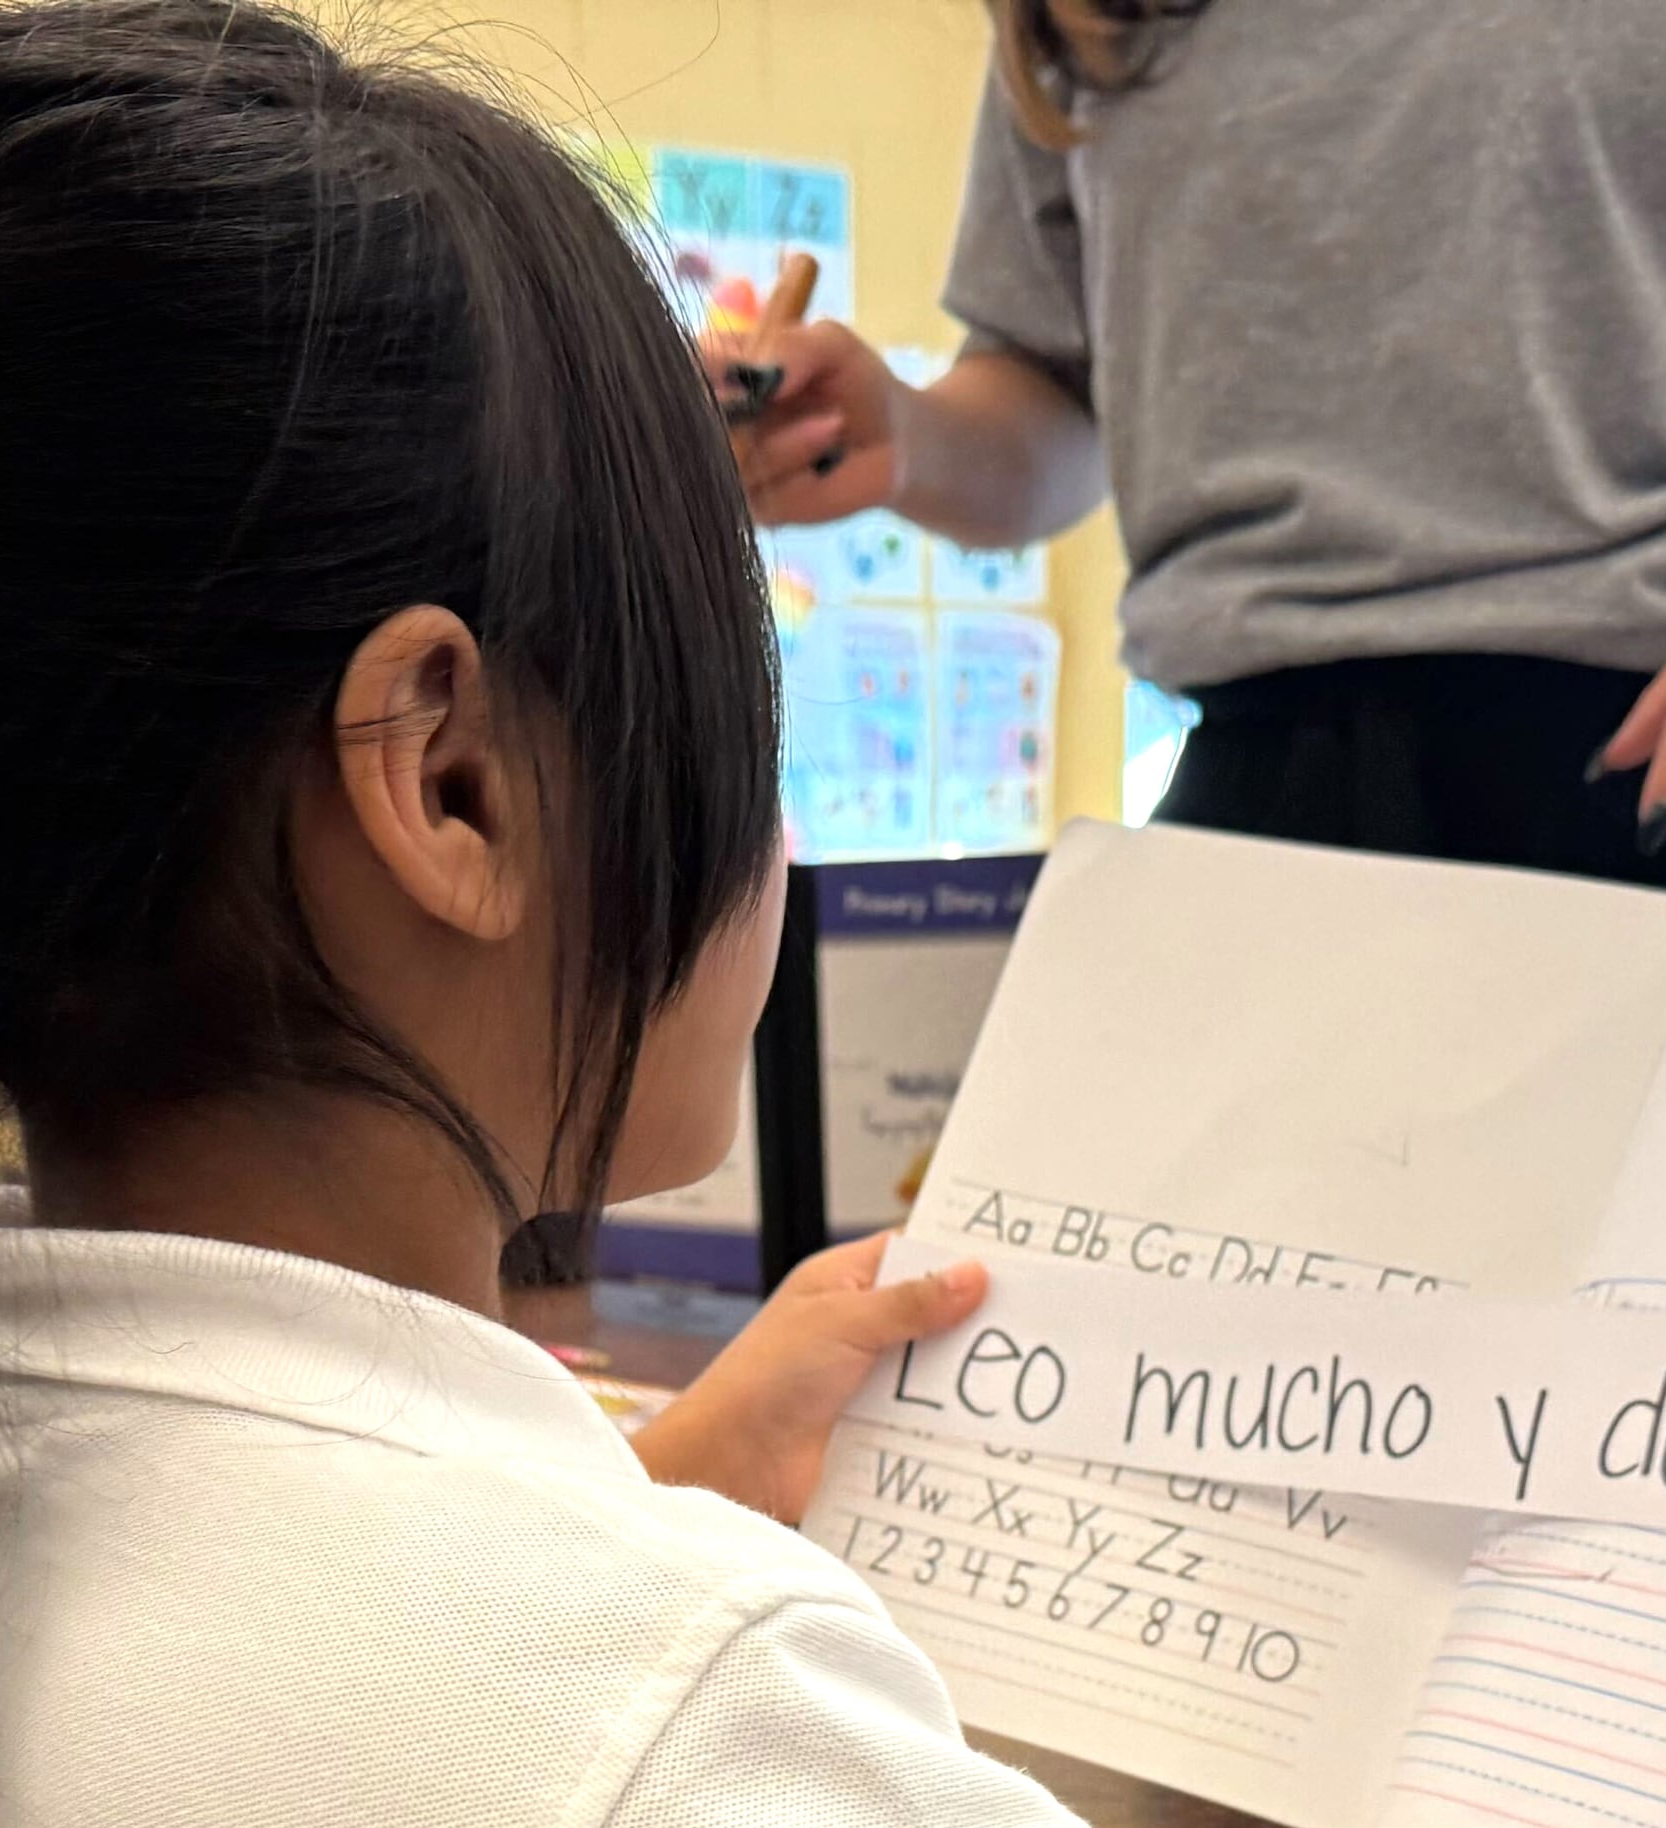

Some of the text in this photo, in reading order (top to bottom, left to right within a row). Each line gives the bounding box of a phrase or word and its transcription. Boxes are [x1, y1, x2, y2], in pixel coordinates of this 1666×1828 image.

[963, 1191, 1033, 1246] Aa
[1051, 1206, 1110, 1262] Bb
[1131, 1224, 1193, 1280] Cc
[894, 1328, 1067, 1424] Leo
[1125, 1352, 1434, 1460] mucho
[1494, 1387, 1548, 1502] y
[876, 1450, 1205, 1581] Ww Xx Yy Zz
[869, 1525, 903, 1575] 2
[913, 1536, 945, 1586] 3
[960, 1548, 991, 1597] 4
[1002, 1560, 1036, 1609] 5
[1047, 1573, 1074, 1621] 6
[1086, 1583, 1130, 1630] 7
[1140, 1597, 1173, 1647] 8
[1193, 1609, 1223, 1664] 9
[1236, 1622, 1301, 1682] 10
